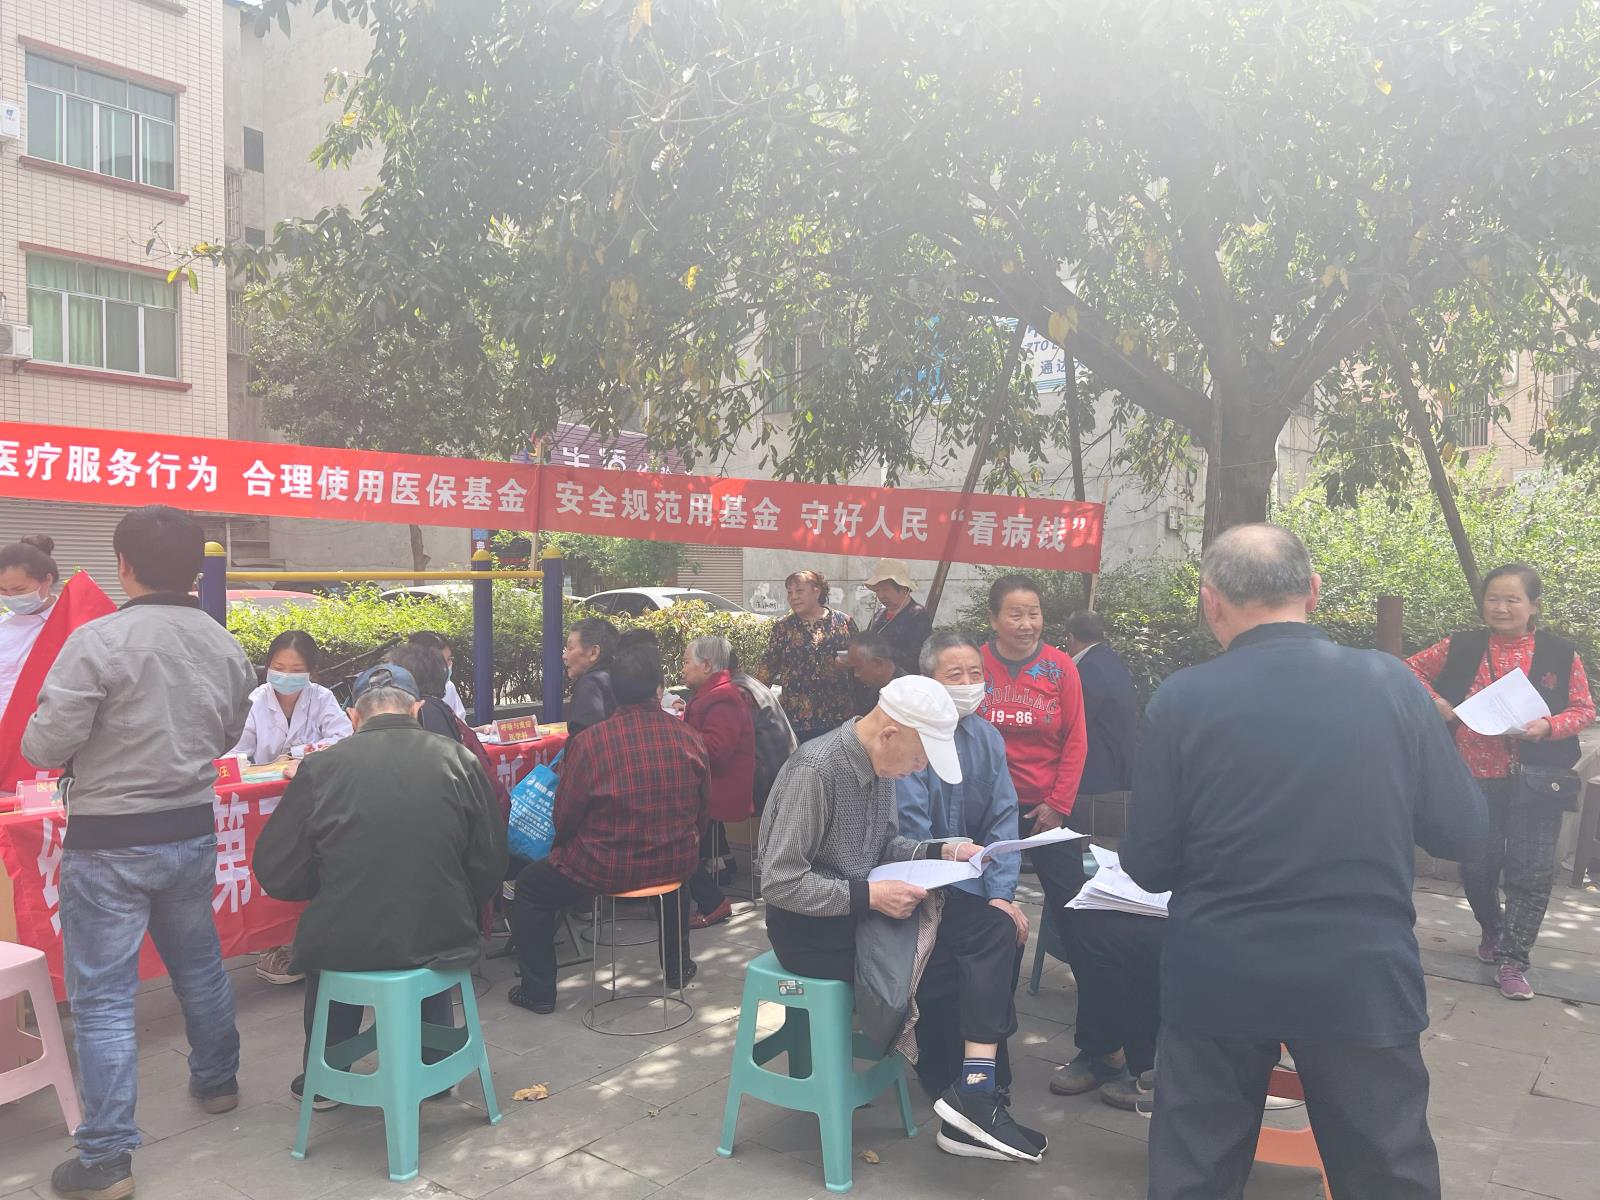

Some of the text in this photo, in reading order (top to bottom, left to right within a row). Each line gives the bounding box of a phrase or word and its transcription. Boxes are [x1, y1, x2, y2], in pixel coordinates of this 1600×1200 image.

[0, 440, 218, 493] 医疗服务行为
[242, 459, 527, 514] 合理使用医保基金
[555, 480, 782, 532] 安全规范用基金
[800, 501, 929, 543] 守好人民
[990, 710, 1033, 725] 19-86
